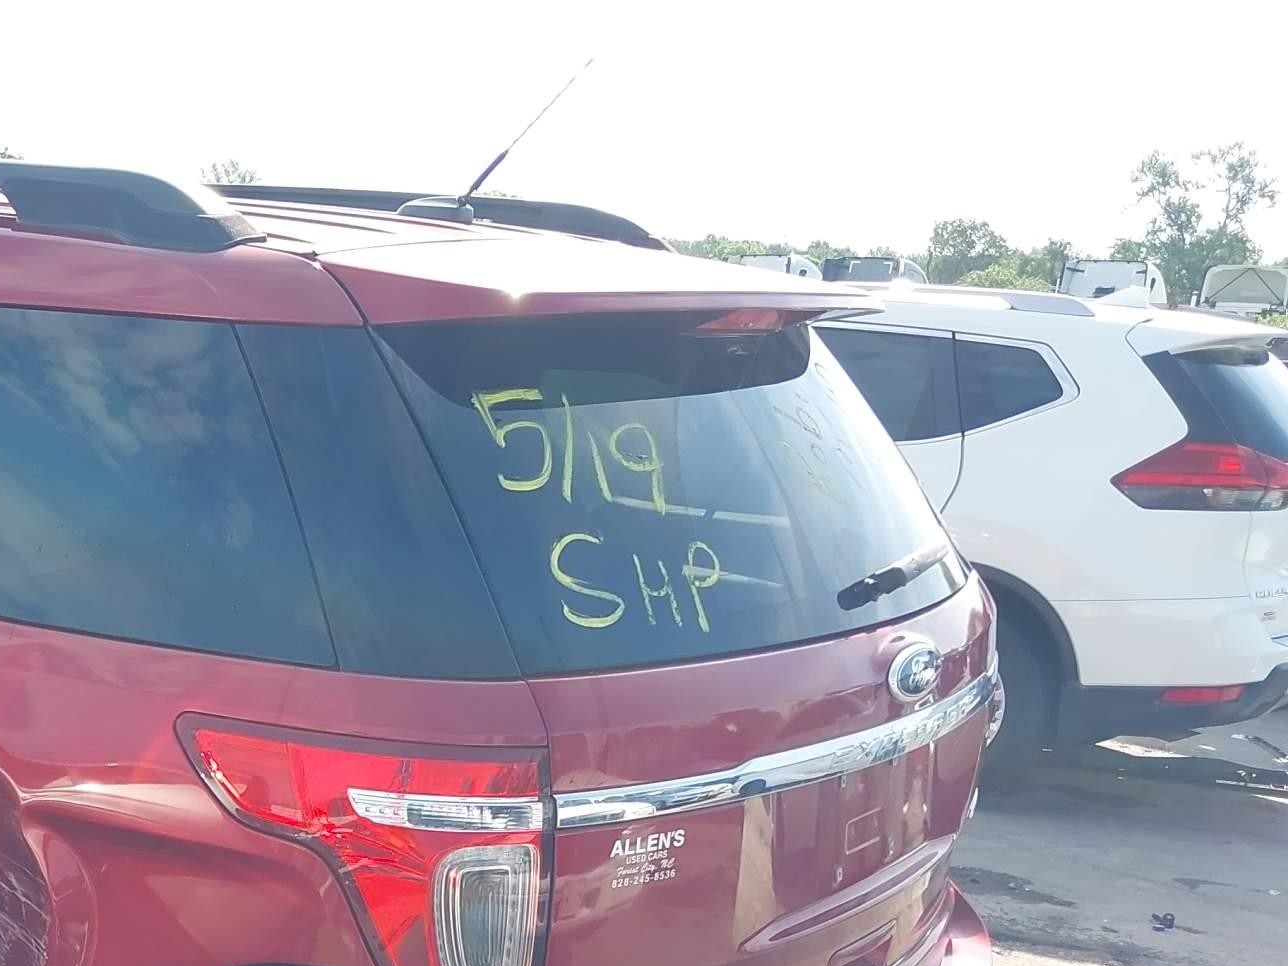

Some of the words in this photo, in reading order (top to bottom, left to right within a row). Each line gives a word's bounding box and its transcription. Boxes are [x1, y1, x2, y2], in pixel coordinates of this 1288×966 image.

[471, 387, 667, 516] 5/19
[549, 531, 721, 633] SHP
[609, 828, 686, 858] ALLEN'S
[625, 854, 647, 865] USED
[647, 849, 669, 861] CARS
[610, 868, 677, 889] 828-245-8536
